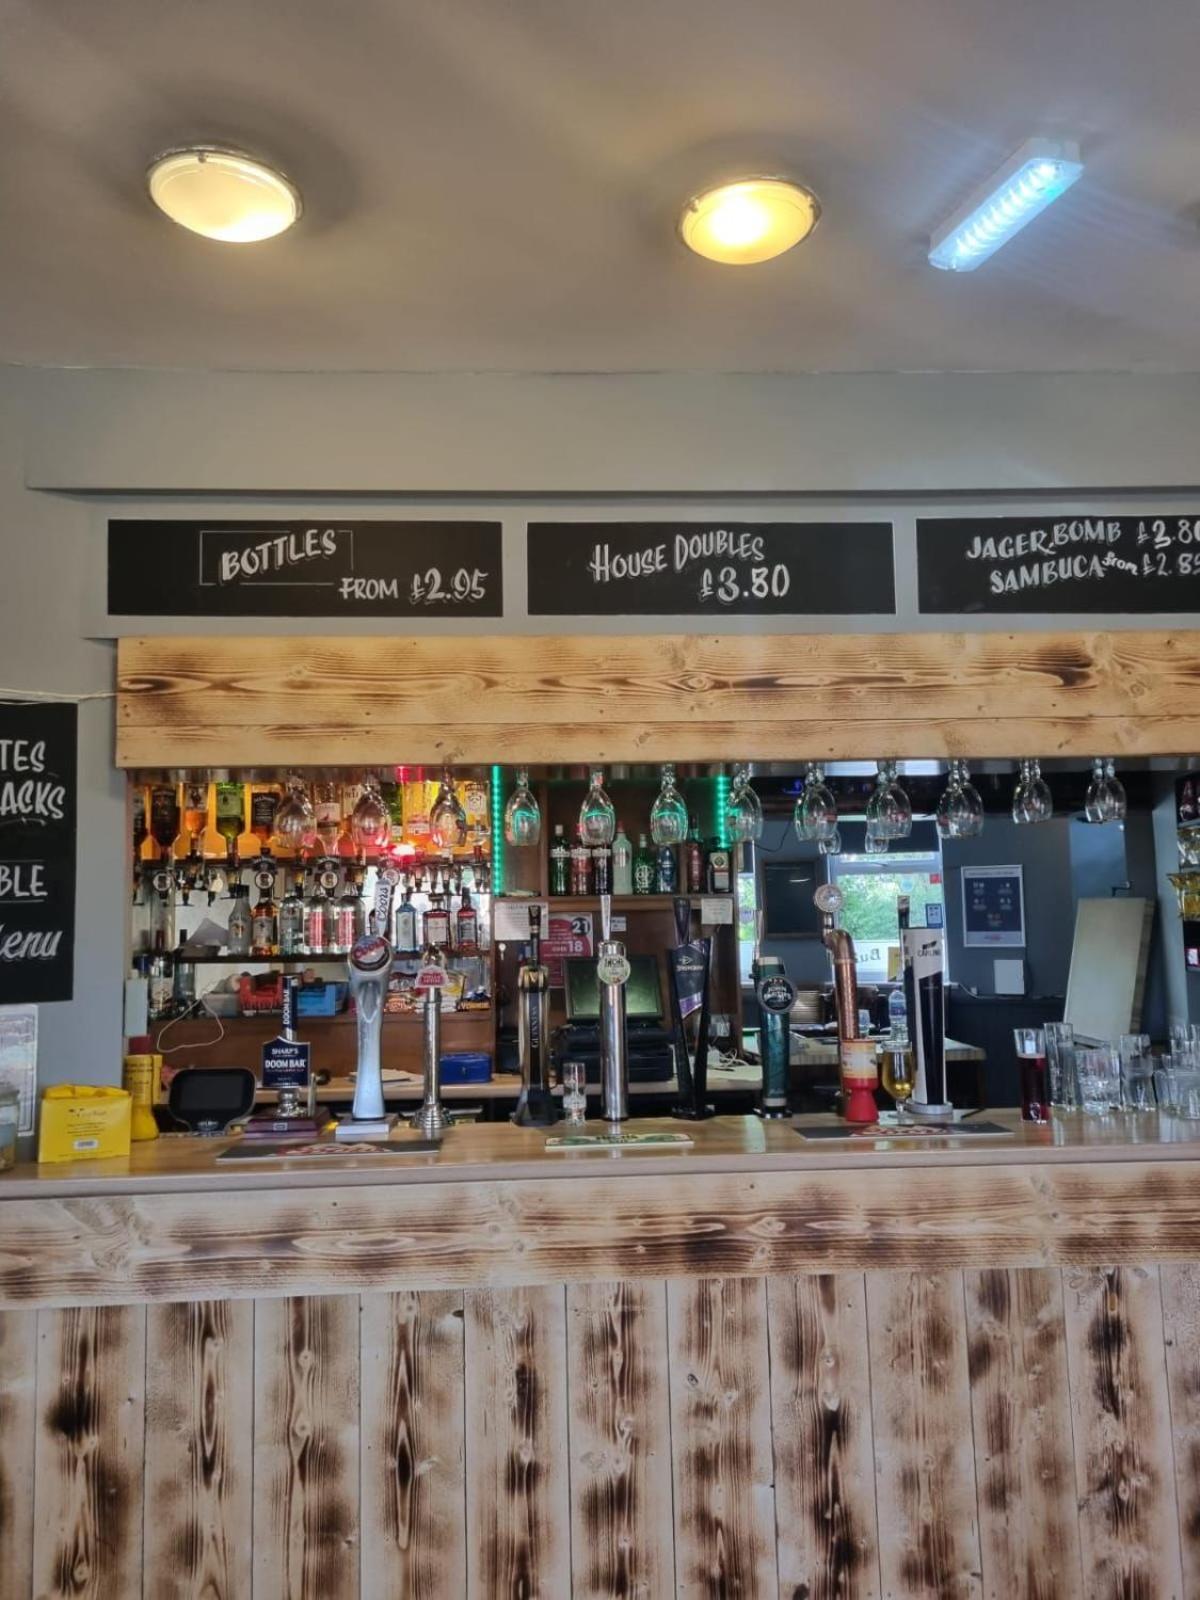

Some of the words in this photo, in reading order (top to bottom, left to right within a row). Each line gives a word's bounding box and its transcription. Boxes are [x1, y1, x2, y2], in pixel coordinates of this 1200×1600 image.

[220, 528, 337, 582] BOTTLES
[588, 543, 668, 582] HOUSE
[675, 529, 765, 571] DOUBLES
[338, 577, 399, 600] FROM
[410, 567, 489, 603] £2.95
[989, 554, 1104, 594] SAMBUCA
[0, 739, 46, 772] TES
[0, 779, 66, 819] ACKS
[0, 865, 48, 897] BLE
[377, 887, 389, 922] Coors
[0, 923, 63, 960] enu
[572, 920, 589, 934] 21
[568, 941, 583, 953] 18
[265, 1060, 288, 1069] DOOM
[289, 1060, 306, 1069] BAR
